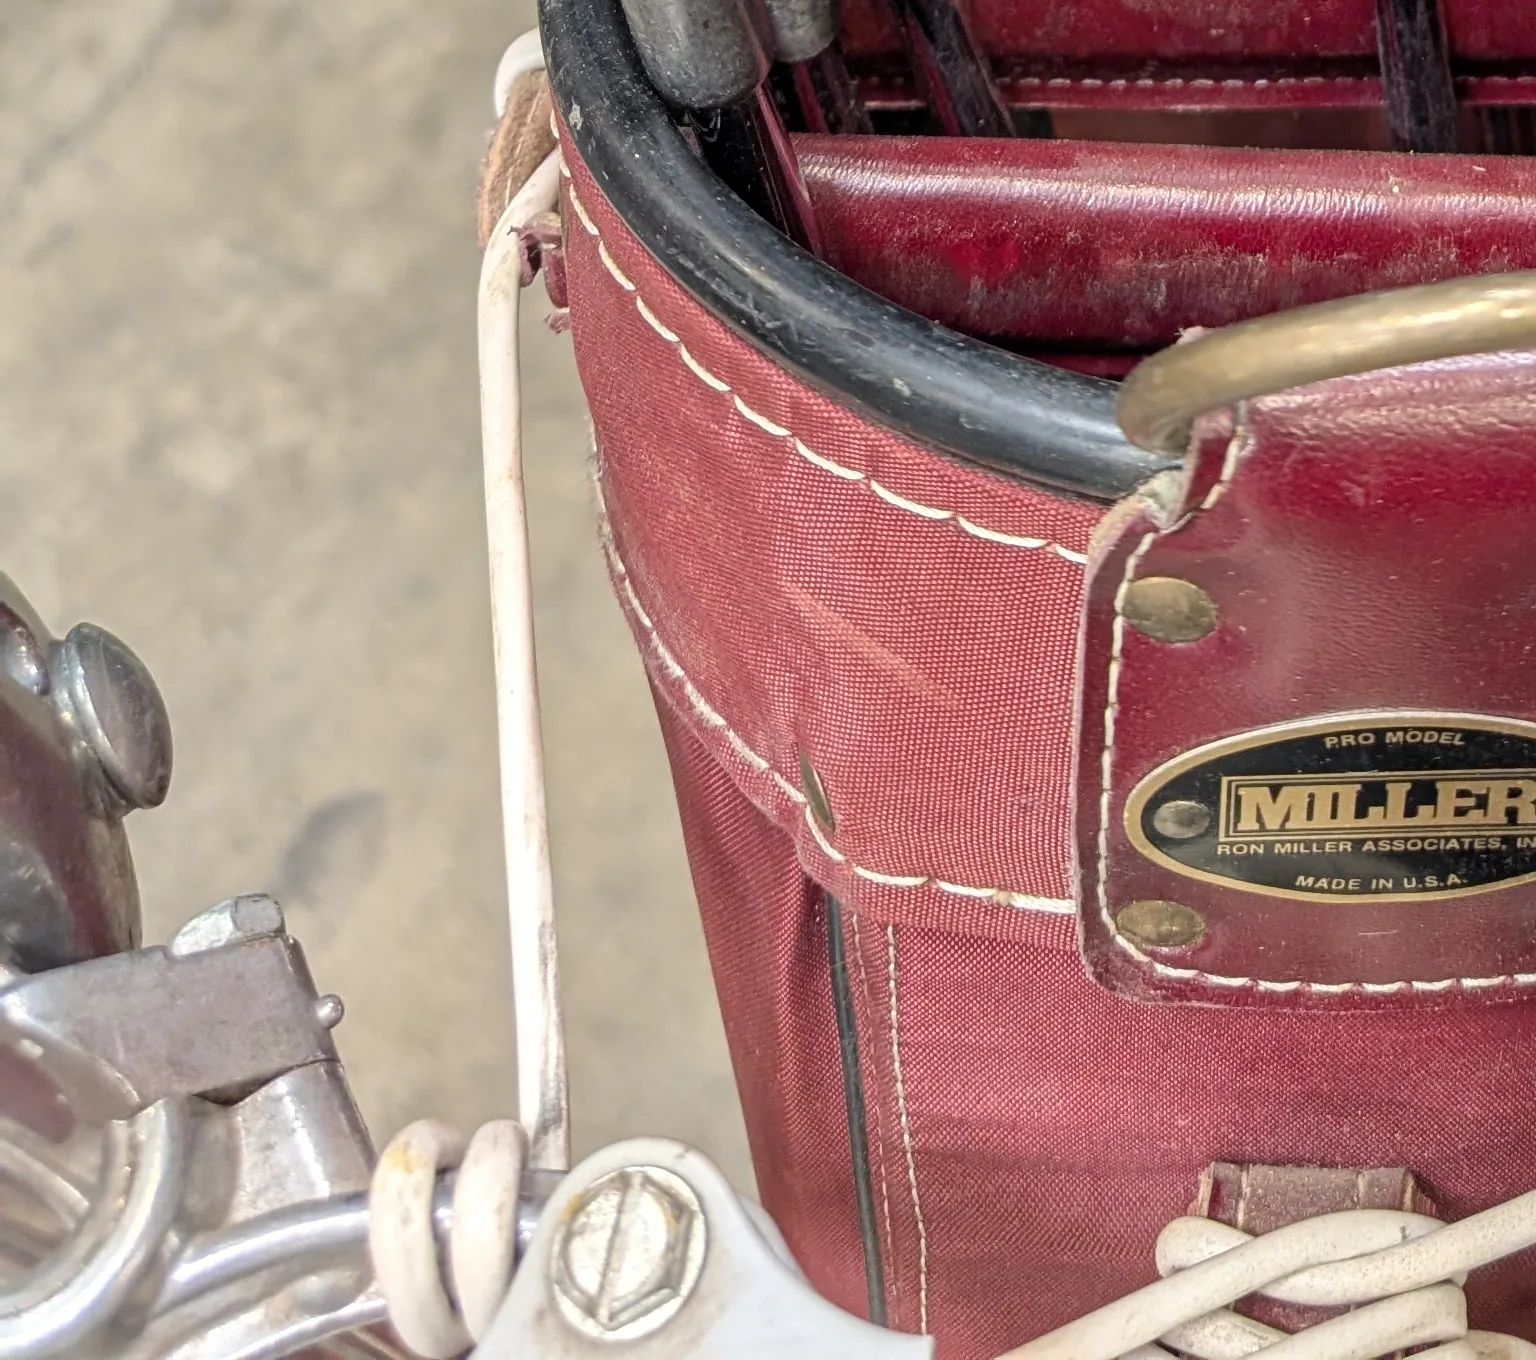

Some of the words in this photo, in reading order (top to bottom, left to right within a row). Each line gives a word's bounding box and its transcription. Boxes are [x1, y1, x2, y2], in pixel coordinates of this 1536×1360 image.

[1325, 733, 1376, 749] PRO
[1385, 729, 1466, 746] MODEL
[1217, 842, 1264, 856] RON
[1274, 840, 1353, 854] MILLER
[1295, 875, 1363, 890] MADE
[1371, 875, 1392, 889] IN
[1403, 874, 1469, 889] U.S.A.
